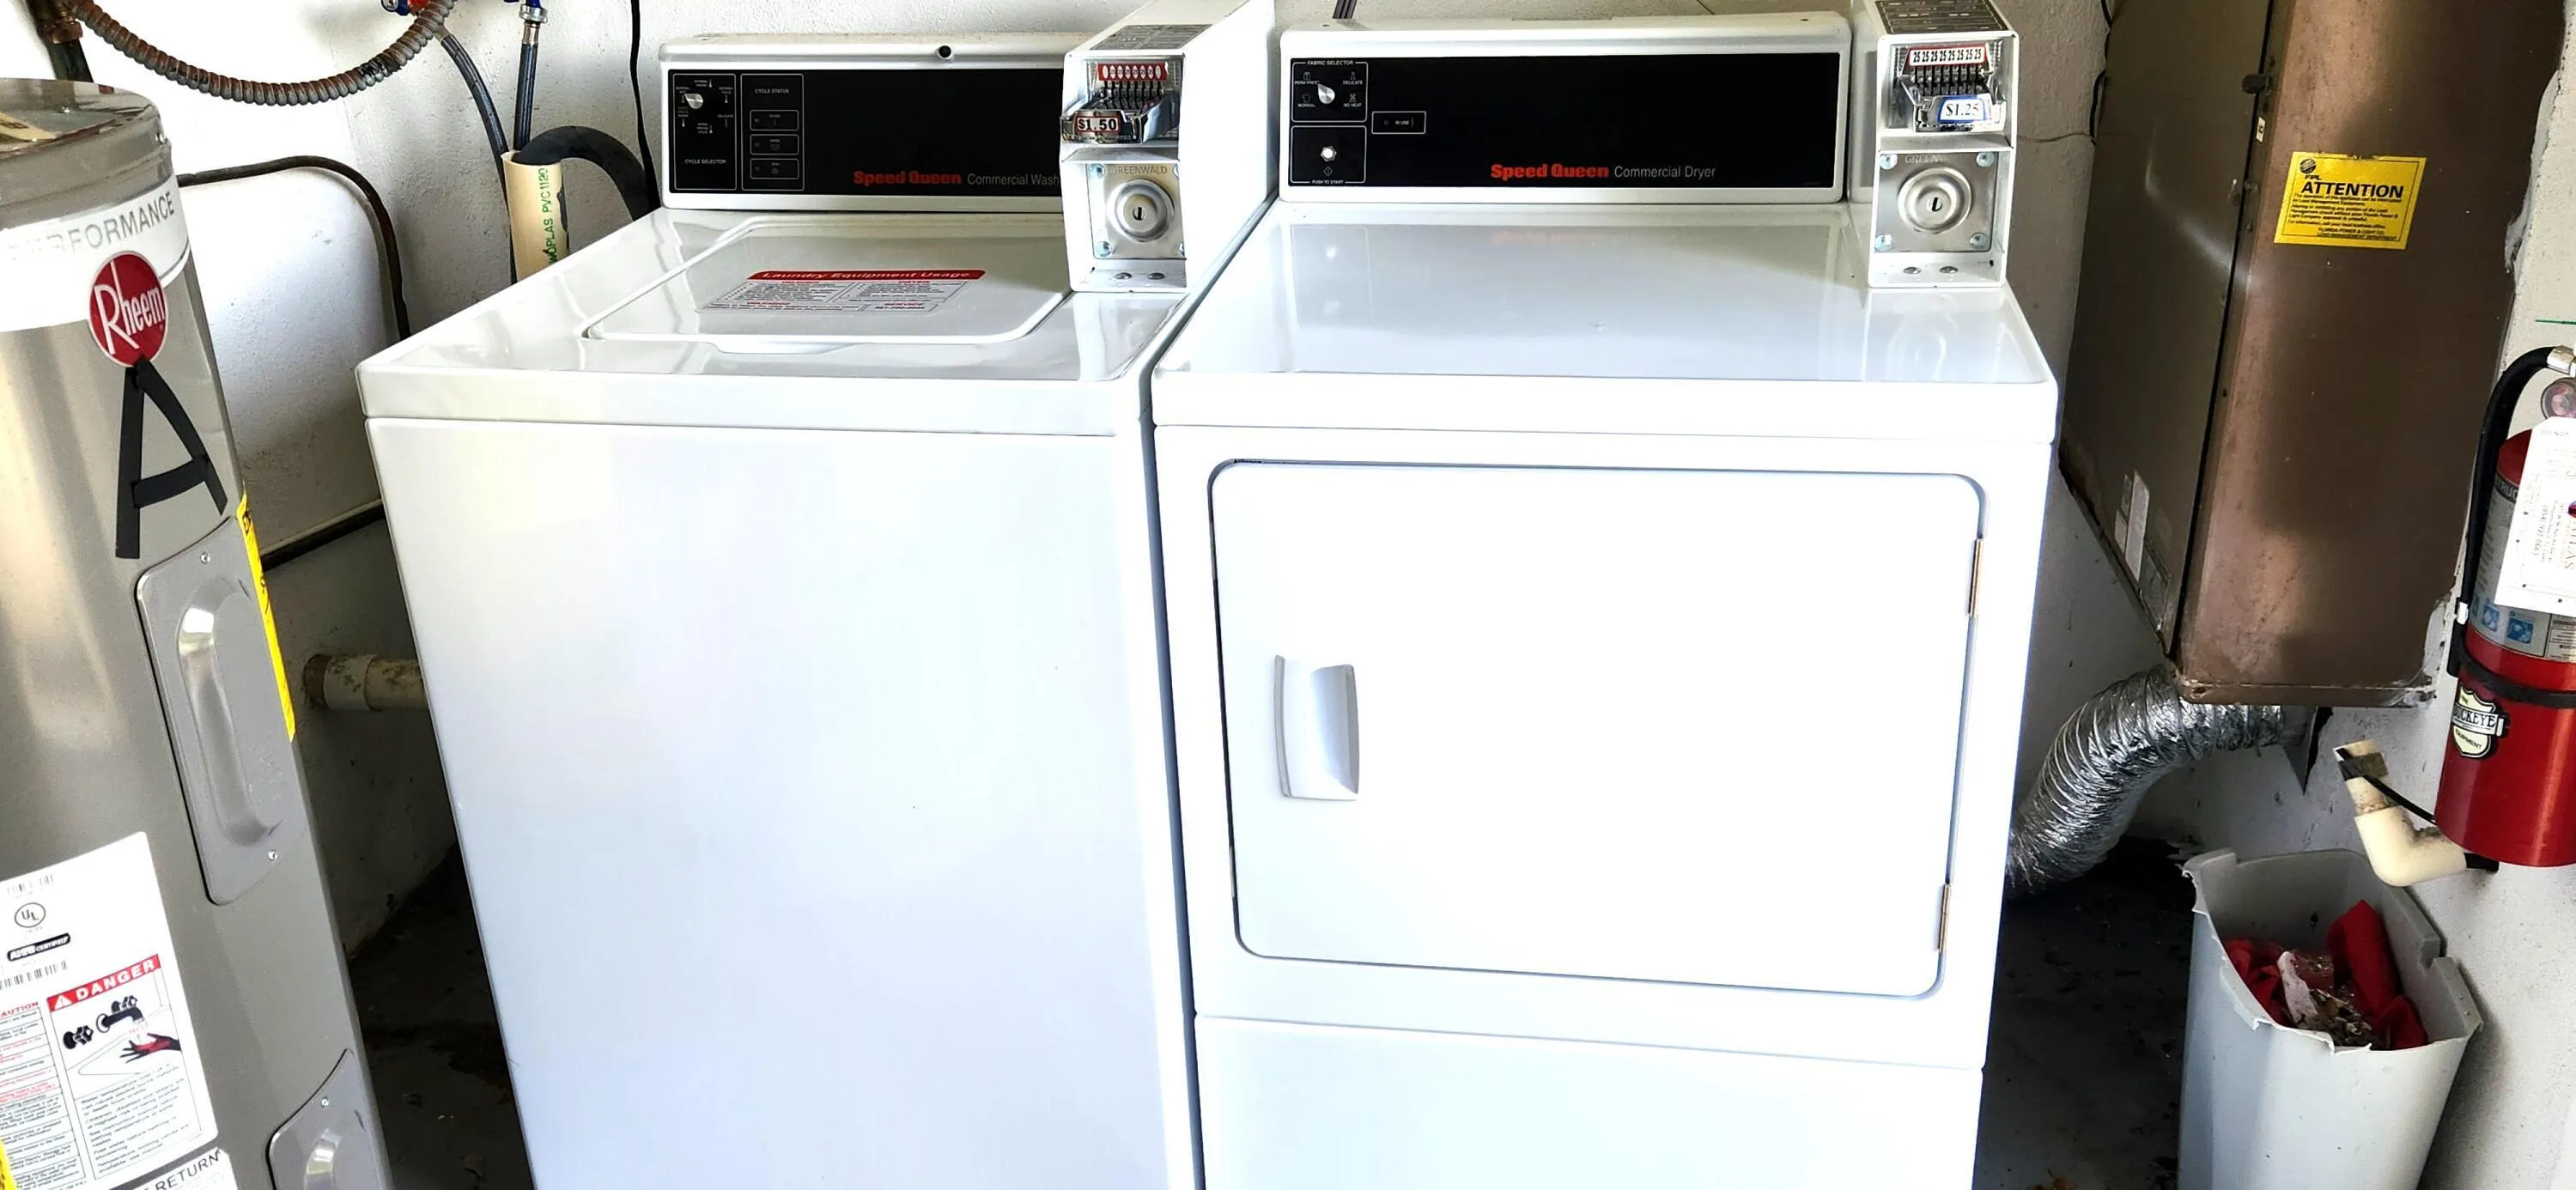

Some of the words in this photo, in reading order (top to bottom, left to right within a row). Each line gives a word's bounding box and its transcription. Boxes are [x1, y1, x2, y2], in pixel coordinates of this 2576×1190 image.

[1913, 52, 1920, 63] 25
[1922, 52, 1929, 63] 25
[1930, 52, 1938, 62] 25
[1939, 52, 1947, 62] 25
[1947, 51, 1955, 61] 25
[1957, 50, 1964, 61] 25
[1965, 49, 1972, 60] 25
[1974, 48, 1982, 60] 25
[1945, 103, 1980, 117] $1.25
[1078, 118, 1117, 131] $1.50
[853, 170, 906, 187] Speed
[908, 170, 963, 185] Queen
[967, 173, 1029, 185] Commercial
[1491, 164, 1546, 181] Speed
[1551, 164, 1609, 179] Queen
[1613, 165, 1680, 179] Commercial
[1684, 166, 1716, 180] Dryer
[2301, 181, 2403, 198] ATTENTION
[7, 191, 175, 261] RFORMANCE
[94, 259, 165, 355] Rheem
[76, 958, 156, 1001] DANGER
[155, 1148, 221, 1190] RETURN
